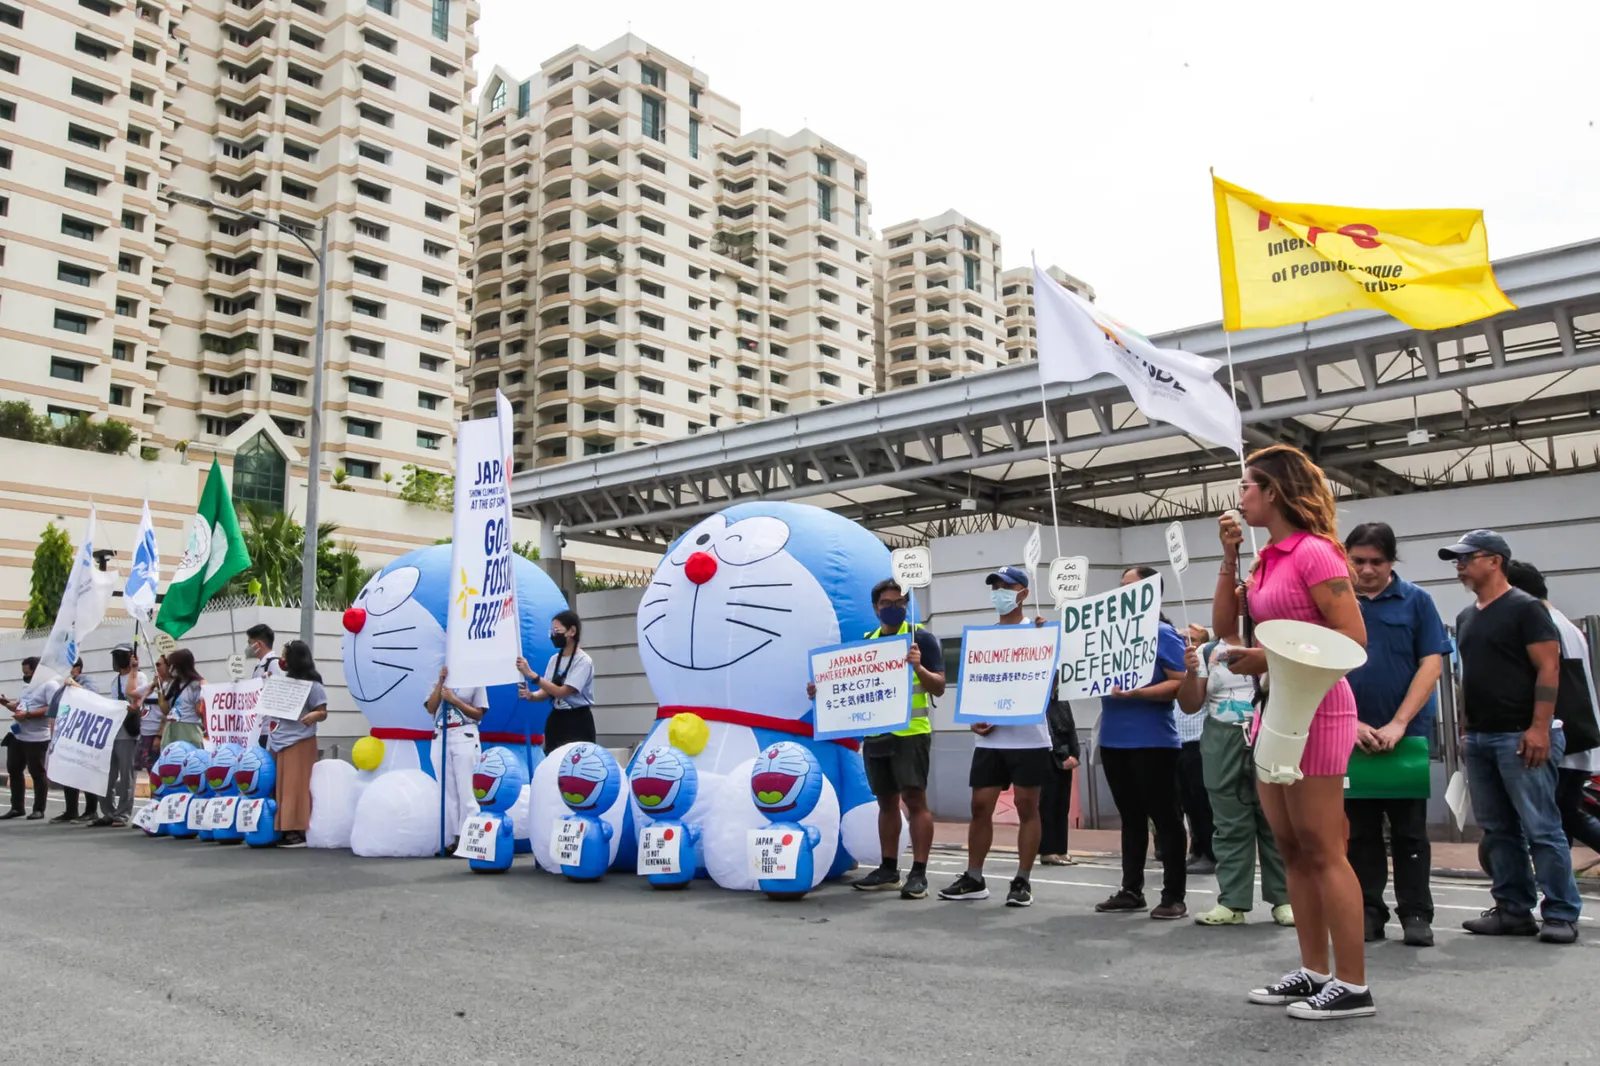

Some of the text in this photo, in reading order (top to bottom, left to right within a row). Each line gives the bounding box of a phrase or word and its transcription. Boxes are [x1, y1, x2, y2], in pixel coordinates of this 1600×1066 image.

[1272, 268, 1287, 283] of
[471, 499, 478, 510] AT
[479, 499, 488, 510] THE
[485, 517, 504, 556] GO
[1065, 583, 1154, 634] DEFEND
[468, 599, 503, 640] FREE!
[1085, 614, 1144, 657] ENVI
[829, 654, 856, 669] JAPAN
[864, 650, 878, 662] G7
[968, 650, 983, 664] END
[984, 648, 1010, 664] CLIMATE
[1061, 636, 1157, 684] DEFENDERS
[815, 670, 834, 683] CLIMATE
[834, 662, 884, 680] REPARATIONS
[62, 708, 114, 750] APNED
[563, 824, 571, 833] G7
[558, 835, 576, 843] CLIMATE
[755, 837, 774, 846] JAPAN
[762, 849, 769, 857] GO
[645, 858, 671, 866] RENEWABLE
[762, 857, 777, 865] FOSSIL
[762, 865, 774, 873] FREE
